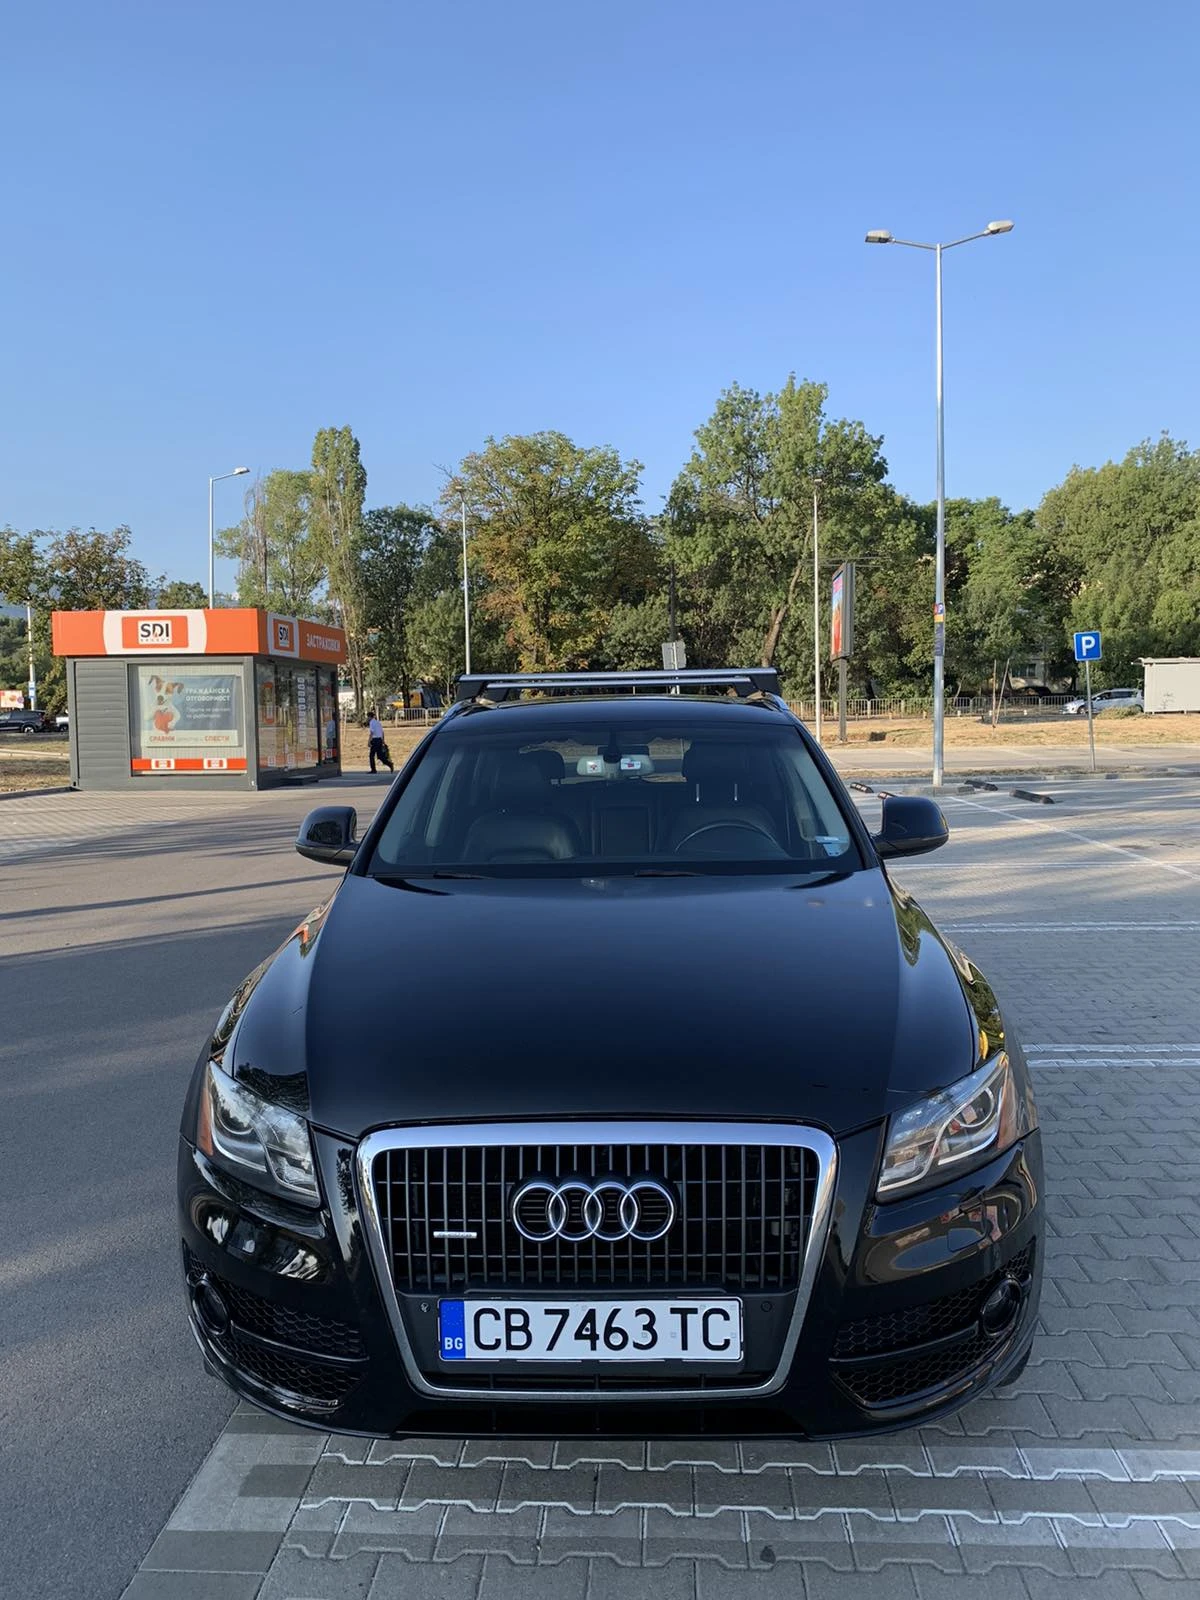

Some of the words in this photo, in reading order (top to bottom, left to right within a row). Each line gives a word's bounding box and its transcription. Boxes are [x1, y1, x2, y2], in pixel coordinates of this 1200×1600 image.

[140, 623, 170, 638] SDI
[279, 626, 289, 641] SDI
[1081, 635, 1096, 657] P
[544, 1307, 658, 1351] 7463
[444, 1337, 464, 1350] BG
